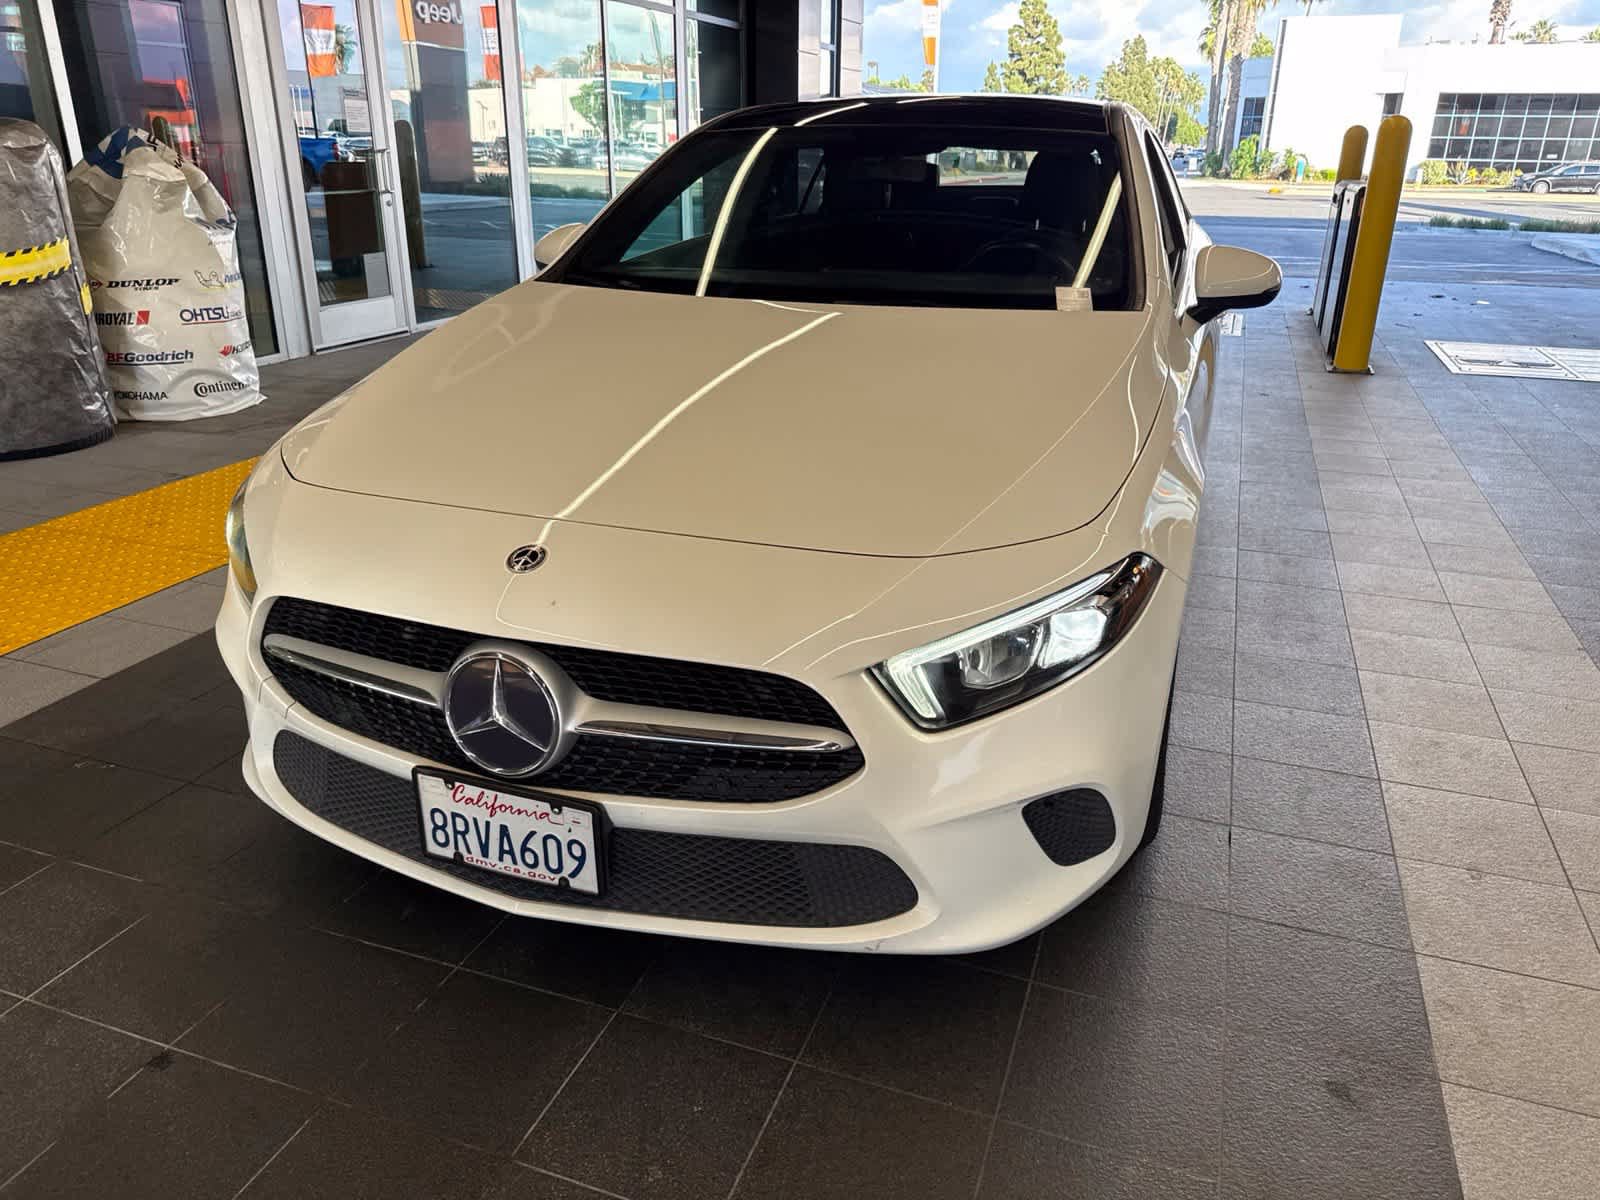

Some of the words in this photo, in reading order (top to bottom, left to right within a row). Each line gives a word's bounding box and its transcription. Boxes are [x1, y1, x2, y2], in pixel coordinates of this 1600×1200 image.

[106, 278, 182, 289] DUNLOP
[106, 350, 194, 362] BFGoodrich
[452, 784, 564, 825] California
[430, 808, 587, 879] 8RVA609
[465, 856, 556, 882] dmv.ca.gov
